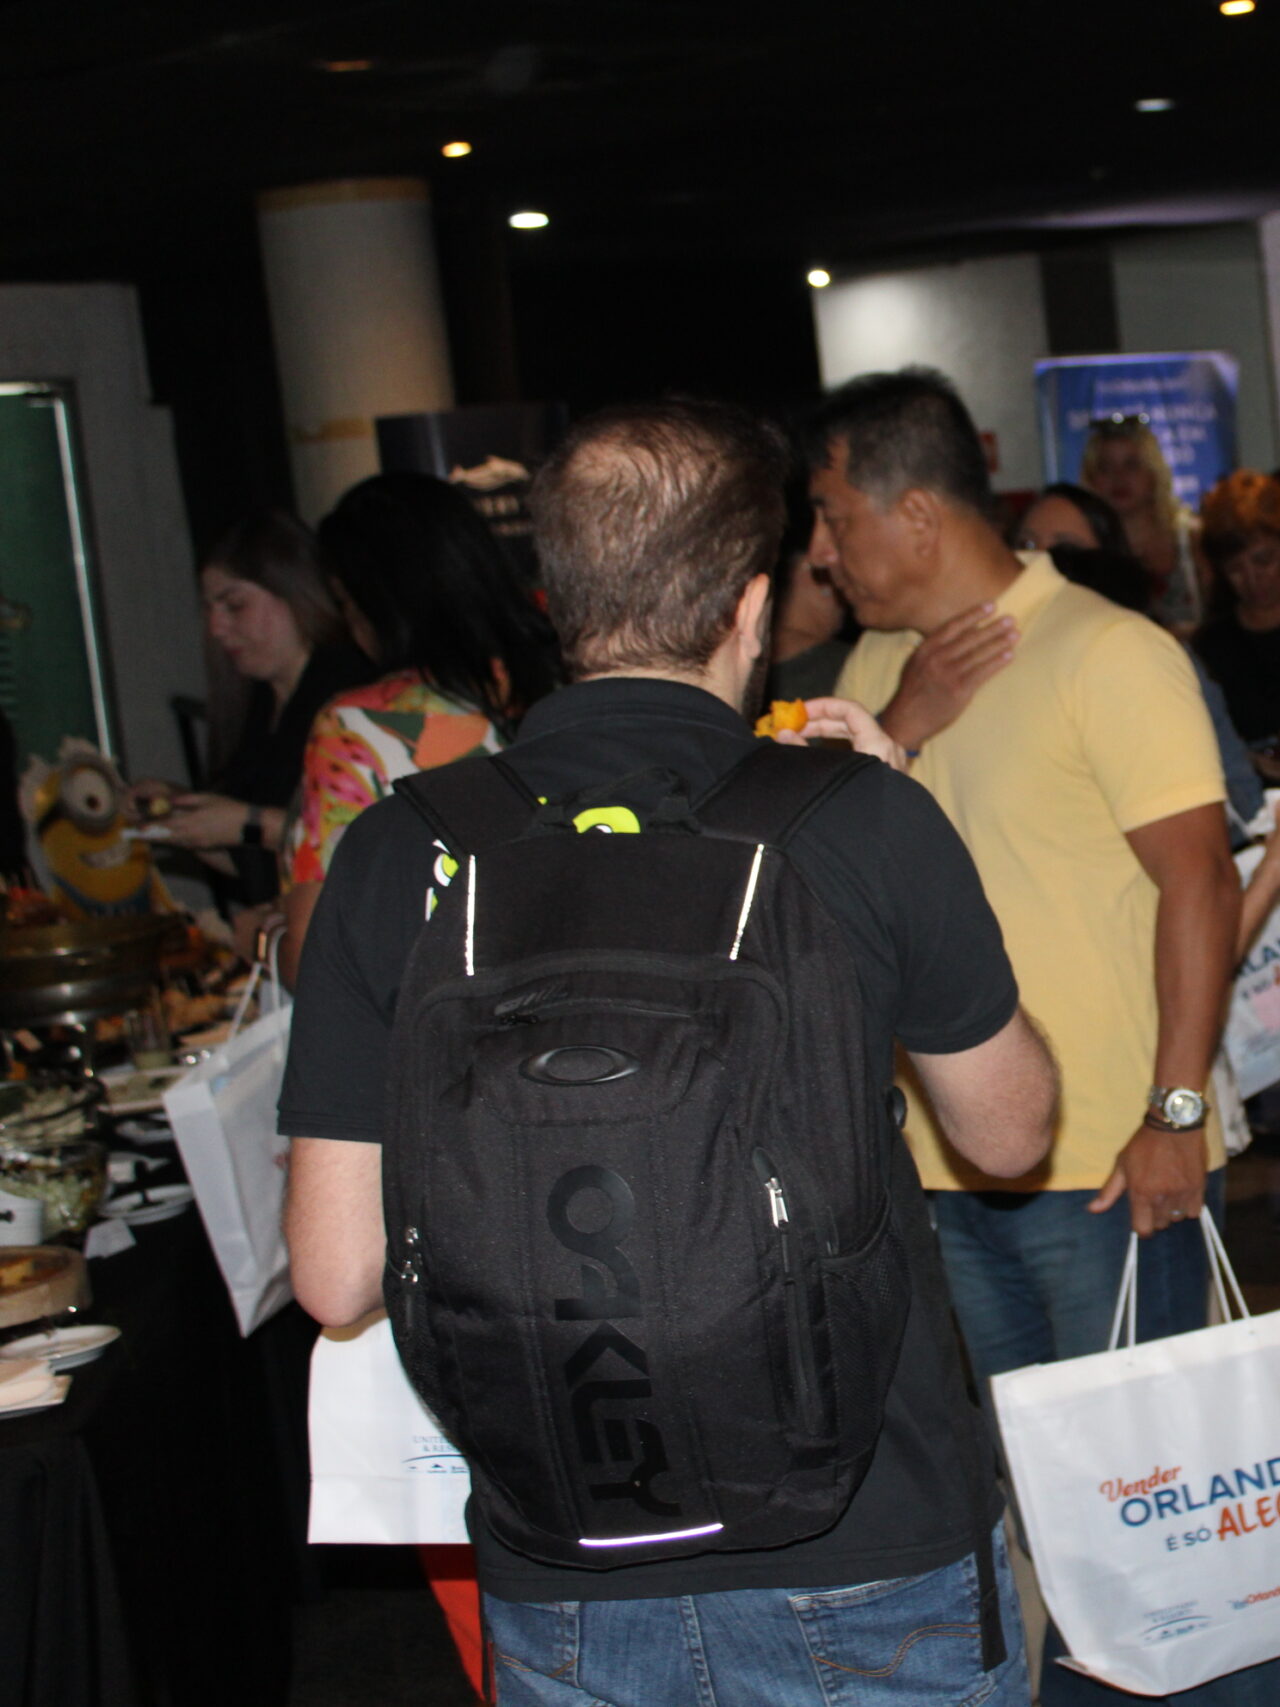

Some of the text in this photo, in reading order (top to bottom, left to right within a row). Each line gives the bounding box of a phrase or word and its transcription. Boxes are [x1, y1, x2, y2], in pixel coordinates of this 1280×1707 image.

[547, 1164, 682, 1517] OAKLEY
[1099, 1466, 1181, 1502] Vender
[1166, 1534, 1179, 1552] É
[1183, 1523, 1213, 1547] SÓ
